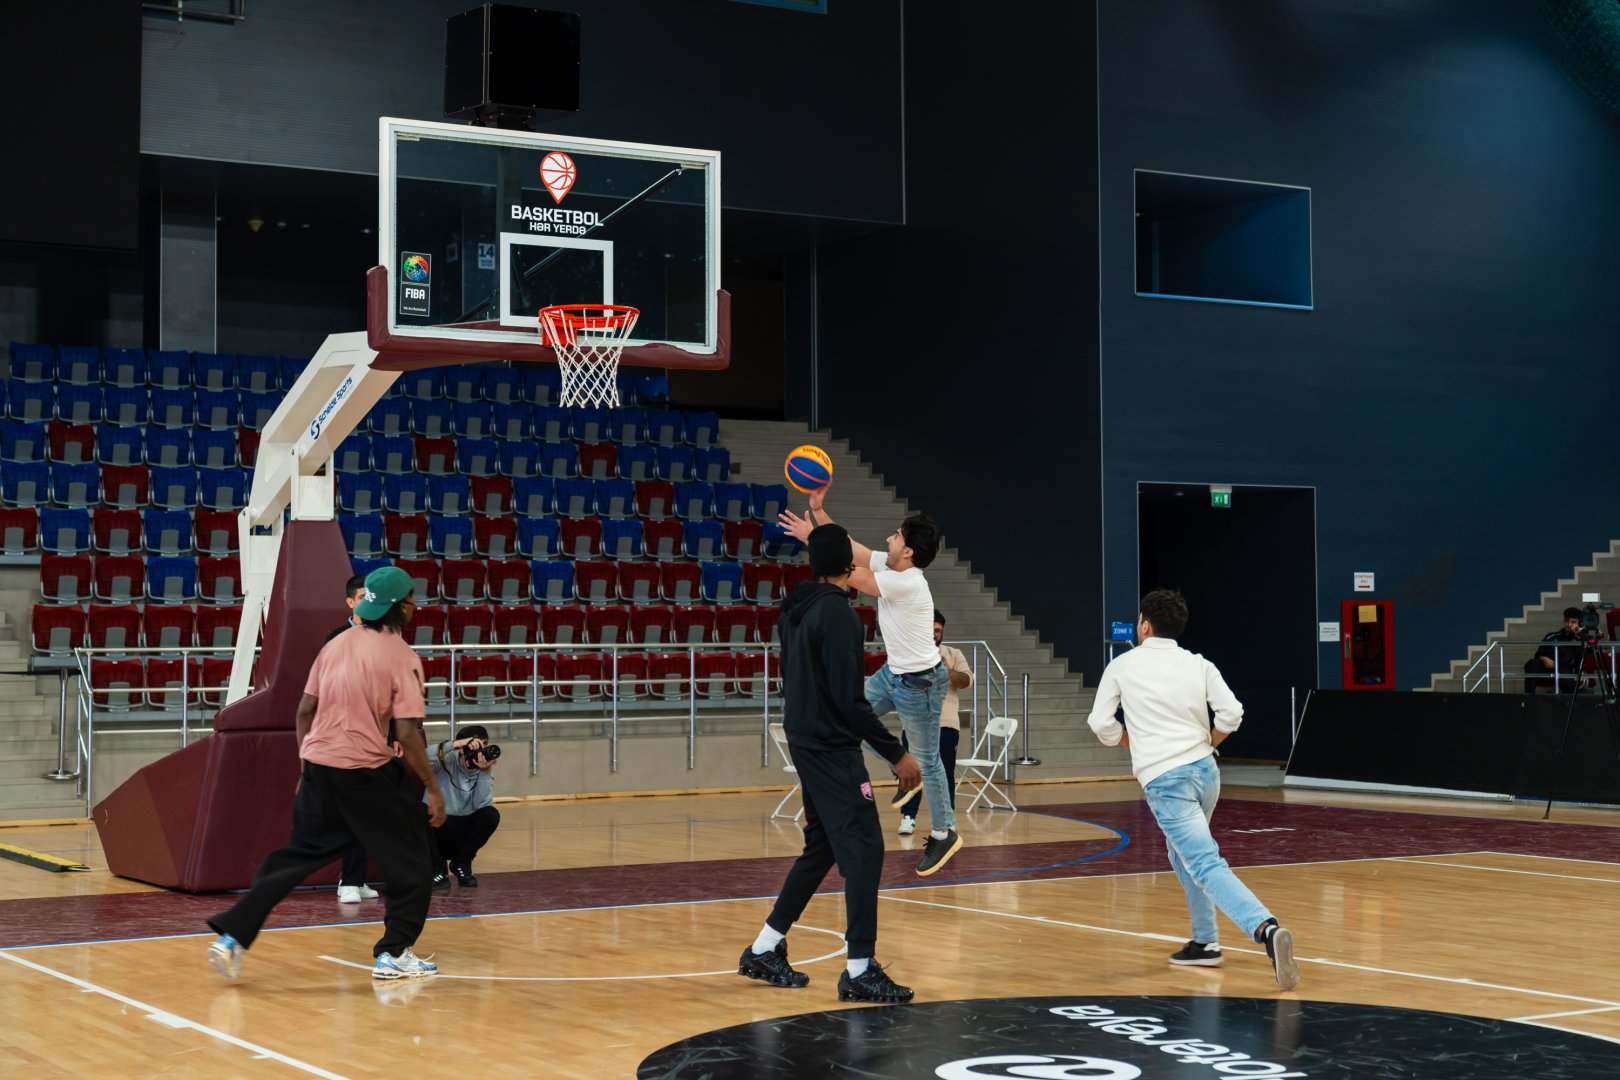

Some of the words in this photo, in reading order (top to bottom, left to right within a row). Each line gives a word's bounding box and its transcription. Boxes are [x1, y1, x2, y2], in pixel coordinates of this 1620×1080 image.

[511, 205, 604, 226] BASKETBOL
[529, 221, 551, 233] HƏR
[553, 223, 586, 235] YERDƏ
[478, 245, 495, 258] 14
[405, 287, 426, 300] FIBA
[1049, 1004, 1308, 1080] lotereya
